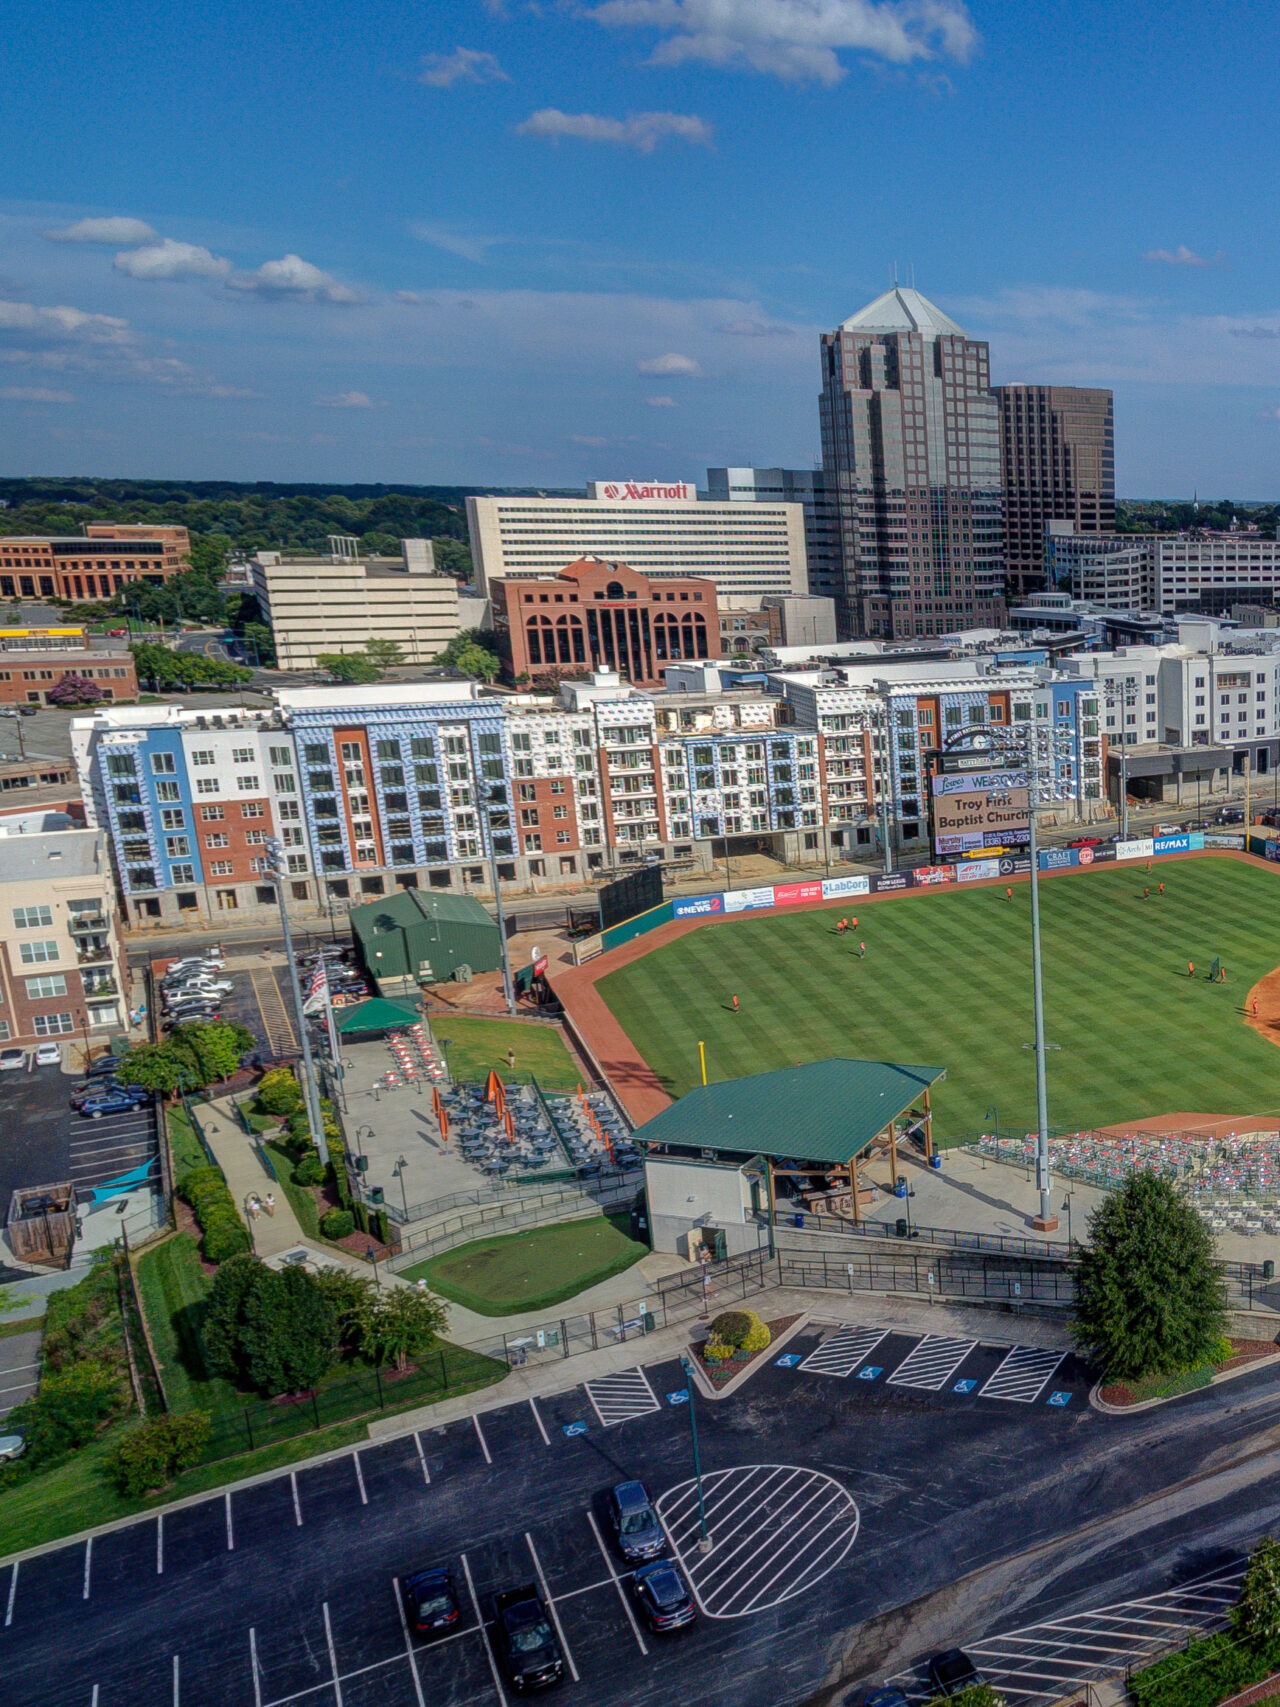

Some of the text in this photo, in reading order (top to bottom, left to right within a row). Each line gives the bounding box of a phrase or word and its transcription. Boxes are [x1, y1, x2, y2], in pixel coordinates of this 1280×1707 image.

[621, 484, 688, 500] Marriott
[955, 797, 1012, 811] Troy First
[940, 809, 1029, 829] Baptist Church
[1002, 833, 1030, 844] 375-230
[1155, 839, 1188, 851] RE/MAX
[1046, 851, 1070, 860] CRAFT
[829, 880, 868, 891] LabCorp
[683, 898, 720, 914] NEWS 2
